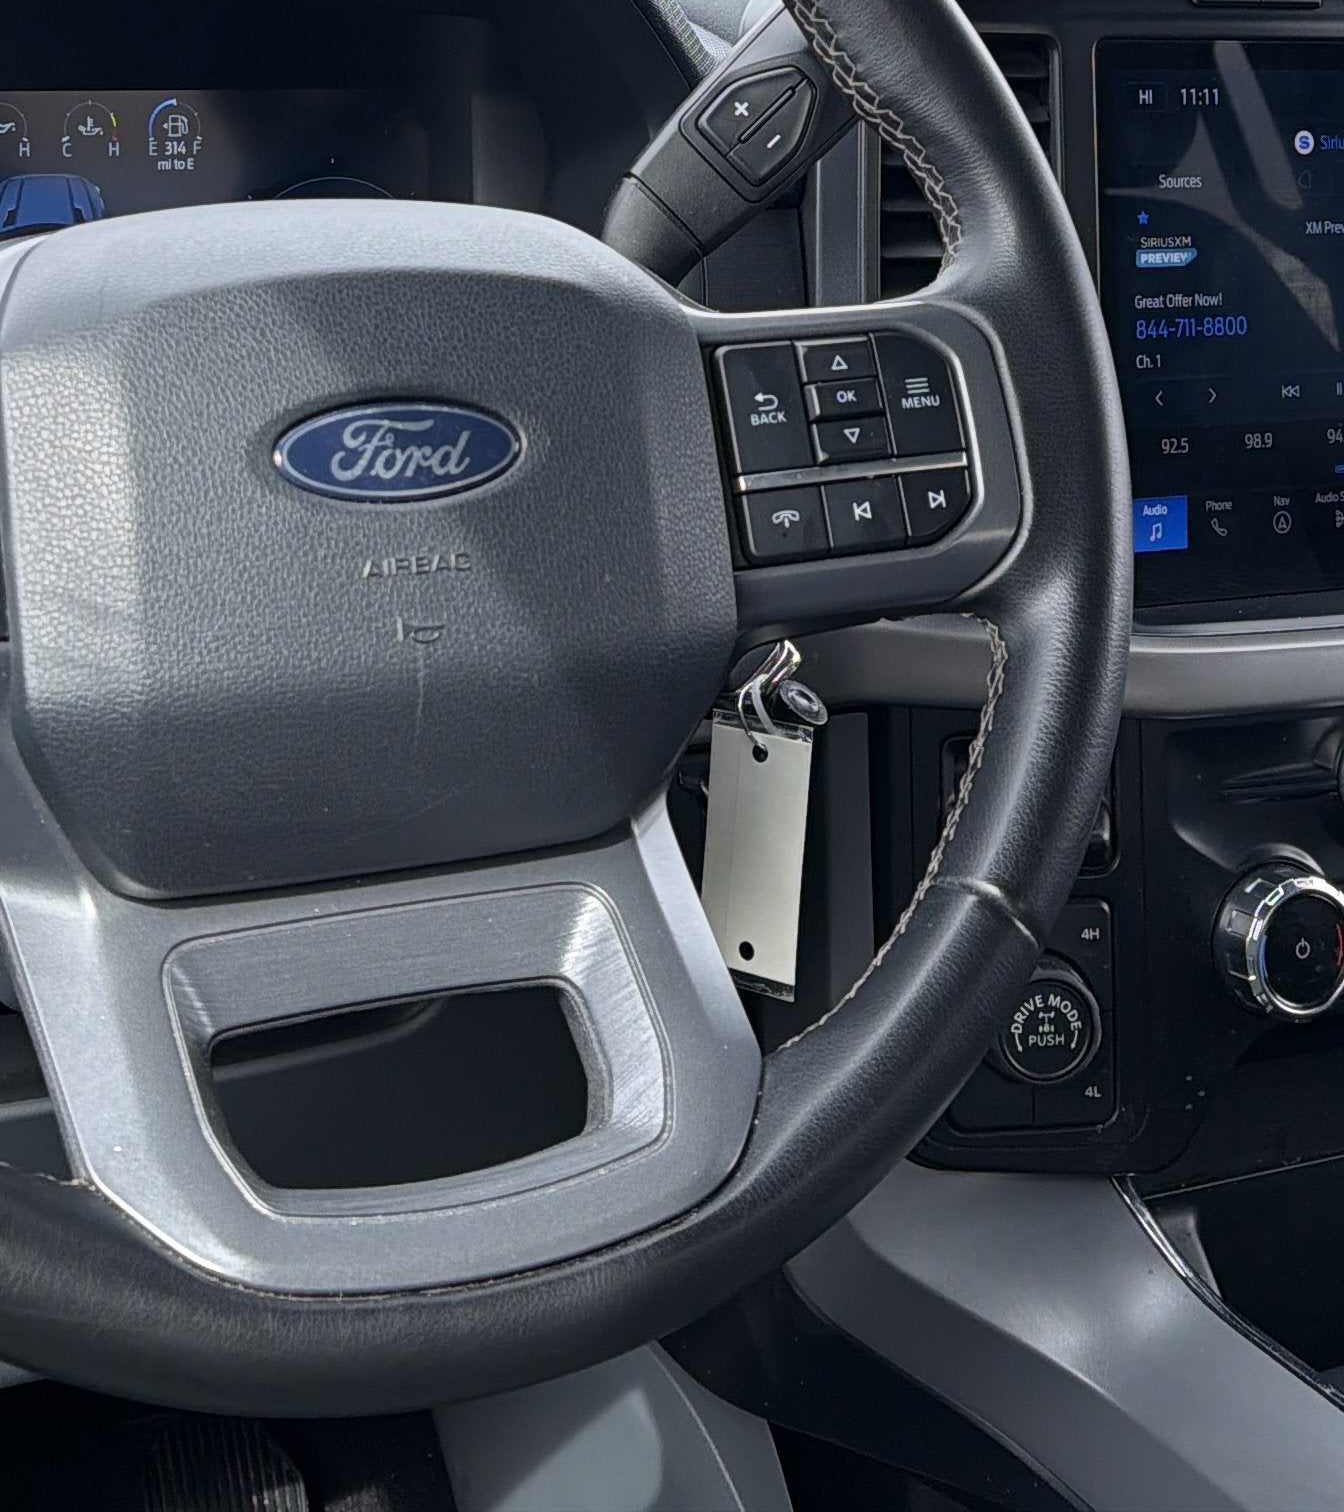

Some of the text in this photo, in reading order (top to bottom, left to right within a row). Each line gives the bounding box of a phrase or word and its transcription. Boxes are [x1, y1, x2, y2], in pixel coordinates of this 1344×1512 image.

[1138, 89, 1153, 105] HI
[1180, 88, 1219, 106] 11:11
[19, 142, 31, 157] H
[62, 143, 72, 158] C
[109, 141, 120, 156] H
[149, 141, 202, 156] E 314 F
[158, 158, 195, 170] mi to E
[1158, 174, 1202, 188] Sources
[1306, 221, 1322, 235] XM
[1140, 236, 1192, 248] SIRIUSXM
[1134, 293, 1223, 309] Great Offer Now!
[1136, 315, 1248, 340] 844-711-8800
[1136, 355, 1154, 368] Ch.
[836, 389, 857, 403] OK
[901, 395, 941, 409] MENU
[750, 411, 787, 426] BACK
[1161, 438, 1189, 454] 92.5
[1244, 433, 1273, 449] 98.9
[331, 419, 473, 482] Ford
[1273, 495, 1290, 506] Nav
[1315, 492, 1338, 504] Audio
[1142, 504, 1168, 516] Audio
[1205, 500, 1233, 511] Phone
[362, 552, 472, 578] AIRBAG
[1081, 928, 1100, 940] 4H
[1011, 993, 1082, 1035] DRIVE MODE
[1028, 1034, 1065, 1047] PUSH
[1085, 1086, 1102, 1098] 4L
